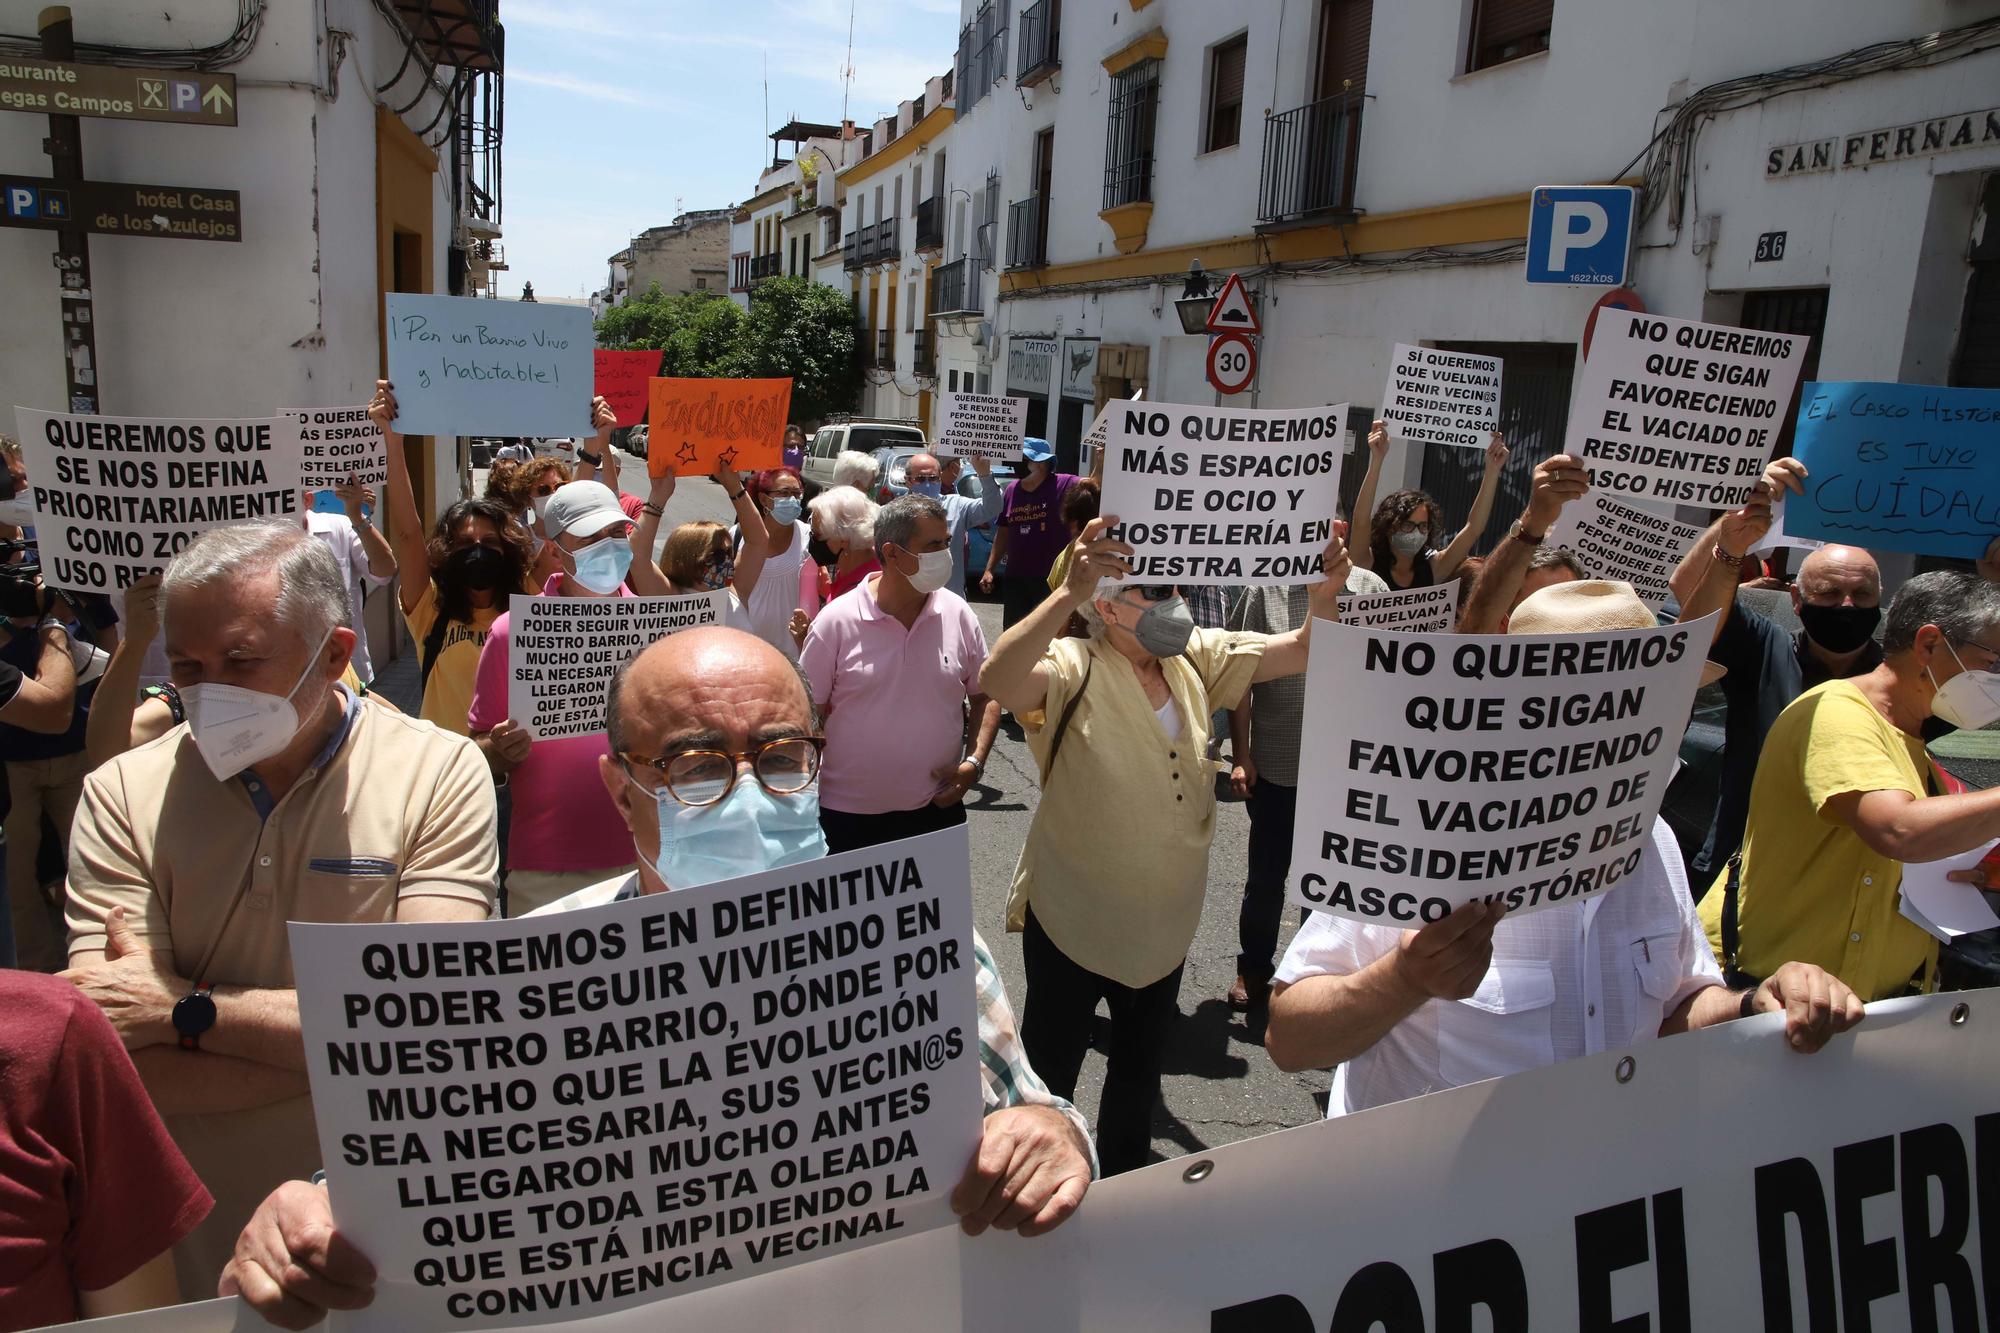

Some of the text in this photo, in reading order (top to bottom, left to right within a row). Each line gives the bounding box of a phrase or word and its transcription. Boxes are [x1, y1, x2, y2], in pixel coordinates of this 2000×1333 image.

[54, 92, 134, 115] Campos
[176, 84, 196, 109] P
[1767, 142, 1832, 175] SAN
[12, 189, 235, 215] P hotel Casa
[96, 213, 236, 238] de los Azulejos
[1548, 201, 1609, 272] P
[1758, 234, 1785, 259] 36
[1570, 274, 1614, 283] 1622 KDS
[452, 333, 473, 344] un
[532, 329, 569, 351] Vivo
[1025, 341, 1058, 354] TATTOO
[1629, 318, 1792, 358] NO QUEREMOS
[418, 356, 560, 389] y habitable!
[1220, 352, 1247, 372] 30
[1397, 365, 1498, 387] QUE VUELVAN A
[1408, 350, 1495, 372] SÍ QUEREMOS
[1646, 354, 1770, 388] QUE SIGAN
[955, 395, 998, 404] QUEREMOS
[1396, 380, 1496, 402] VENIR VECIN@S
[1396, 396, 1492, 416] RESIDENTES A
[1609, 380, 1776, 418] FAVORECIENDO
[950, 412, 976, 420] PEPCH
[970, 405, 999, 413] REVISE
[1384, 408, 1497, 432] NUESTRO CASCO
[1808, 394, 1837, 421] EL
[1851, 393, 1909, 418] CASCO
[46, 419, 271, 454] QUEREMOS QUE
[946, 430, 1018, 441] CASCO HISTÓRICO
[954, 422, 1000, 431] CONSIDERE
[1125, 410, 1170, 437] NO
[1181, 415, 1337, 442] QUEREMOS
[1402, 427, 1477, 444] HISTÓRICO
[1602, 410, 1768, 447] EL VACIADO DE
[954, 448, 1007, 459] RESIDENCIAL
[972, 441, 1022, 451] PREFERENTE
[1122, 446, 1332, 477] MÁS ESPACIOS
[1583, 438, 1762, 476] RESIDENTES DEL
[1857, 441, 1977, 465] ES TUYO
[56, 456, 268, 488] SE NOS DEFINA
[34, 487, 295, 523] PRIORITARIAMENTE
[1154, 488, 1304, 511] DE OCIO Y
[1106, 518, 1330, 545] HOSTELERÍA EN
[1596, 498, 1698, 539] QUEREMOS QUE
[1597, 515, 1679, 550] SE REVISE EL
[66, 526, 144, 558] COMO
[1576, 521, 1684, 564] PEPCH DONDE SE
[54, 557, 107, 588] USO
[1252, 553, 1325, 578] ZONA
[524, 611, 715, 632] PODER SEGUIR VIVIENDO EN
[531, 598, 710, 616] QUEREMOS EN DEFINITIVA
[516, 634, 643, 649] NUESTRO BARRIO,
[1366, 631, 1688, 680] NO QUEREMOS
[531, 681, 606, 697] LLEGARON
[532, 706, 599, 727] QUE ESTÁ
[1406, 686, 1645, 732] QUE SIGAN
[1349, 727, 1662, 782] FAVORECIENDO
[1346, 770, 1650, 832] EL VACIADO DE
[1321, 812, 1643, 880] RESIDENTES DEL
[1300, 872, 1452, 923] CASCO
[362, 857, 923, 982] QUEREMOS EN DEFINITIVA
[344, 898, 940, 1028] PODER SEGUIR VIVIENDO EN
[327, 938, 961, 1076] NUESTRO BARRIO, DÓNDE POR
[368, 990, 938, 1121] MUCHO QUE LA EVOLUCIÓN
[342, 1026, 963, 1166] SEA NECESARIA, SUS VECIN@S
[398, 1082, 930, 1208] LLEGARON MUCHO ANTES
[423, 1130, 918, 1247] QUE TODA ESTA OLEADA
[414, 1167, 929, 1286] QUE ESTÁ IMPIDIENDO LA
[447, 1208, 904, 1318] CONVIVENCIA VECINAL
